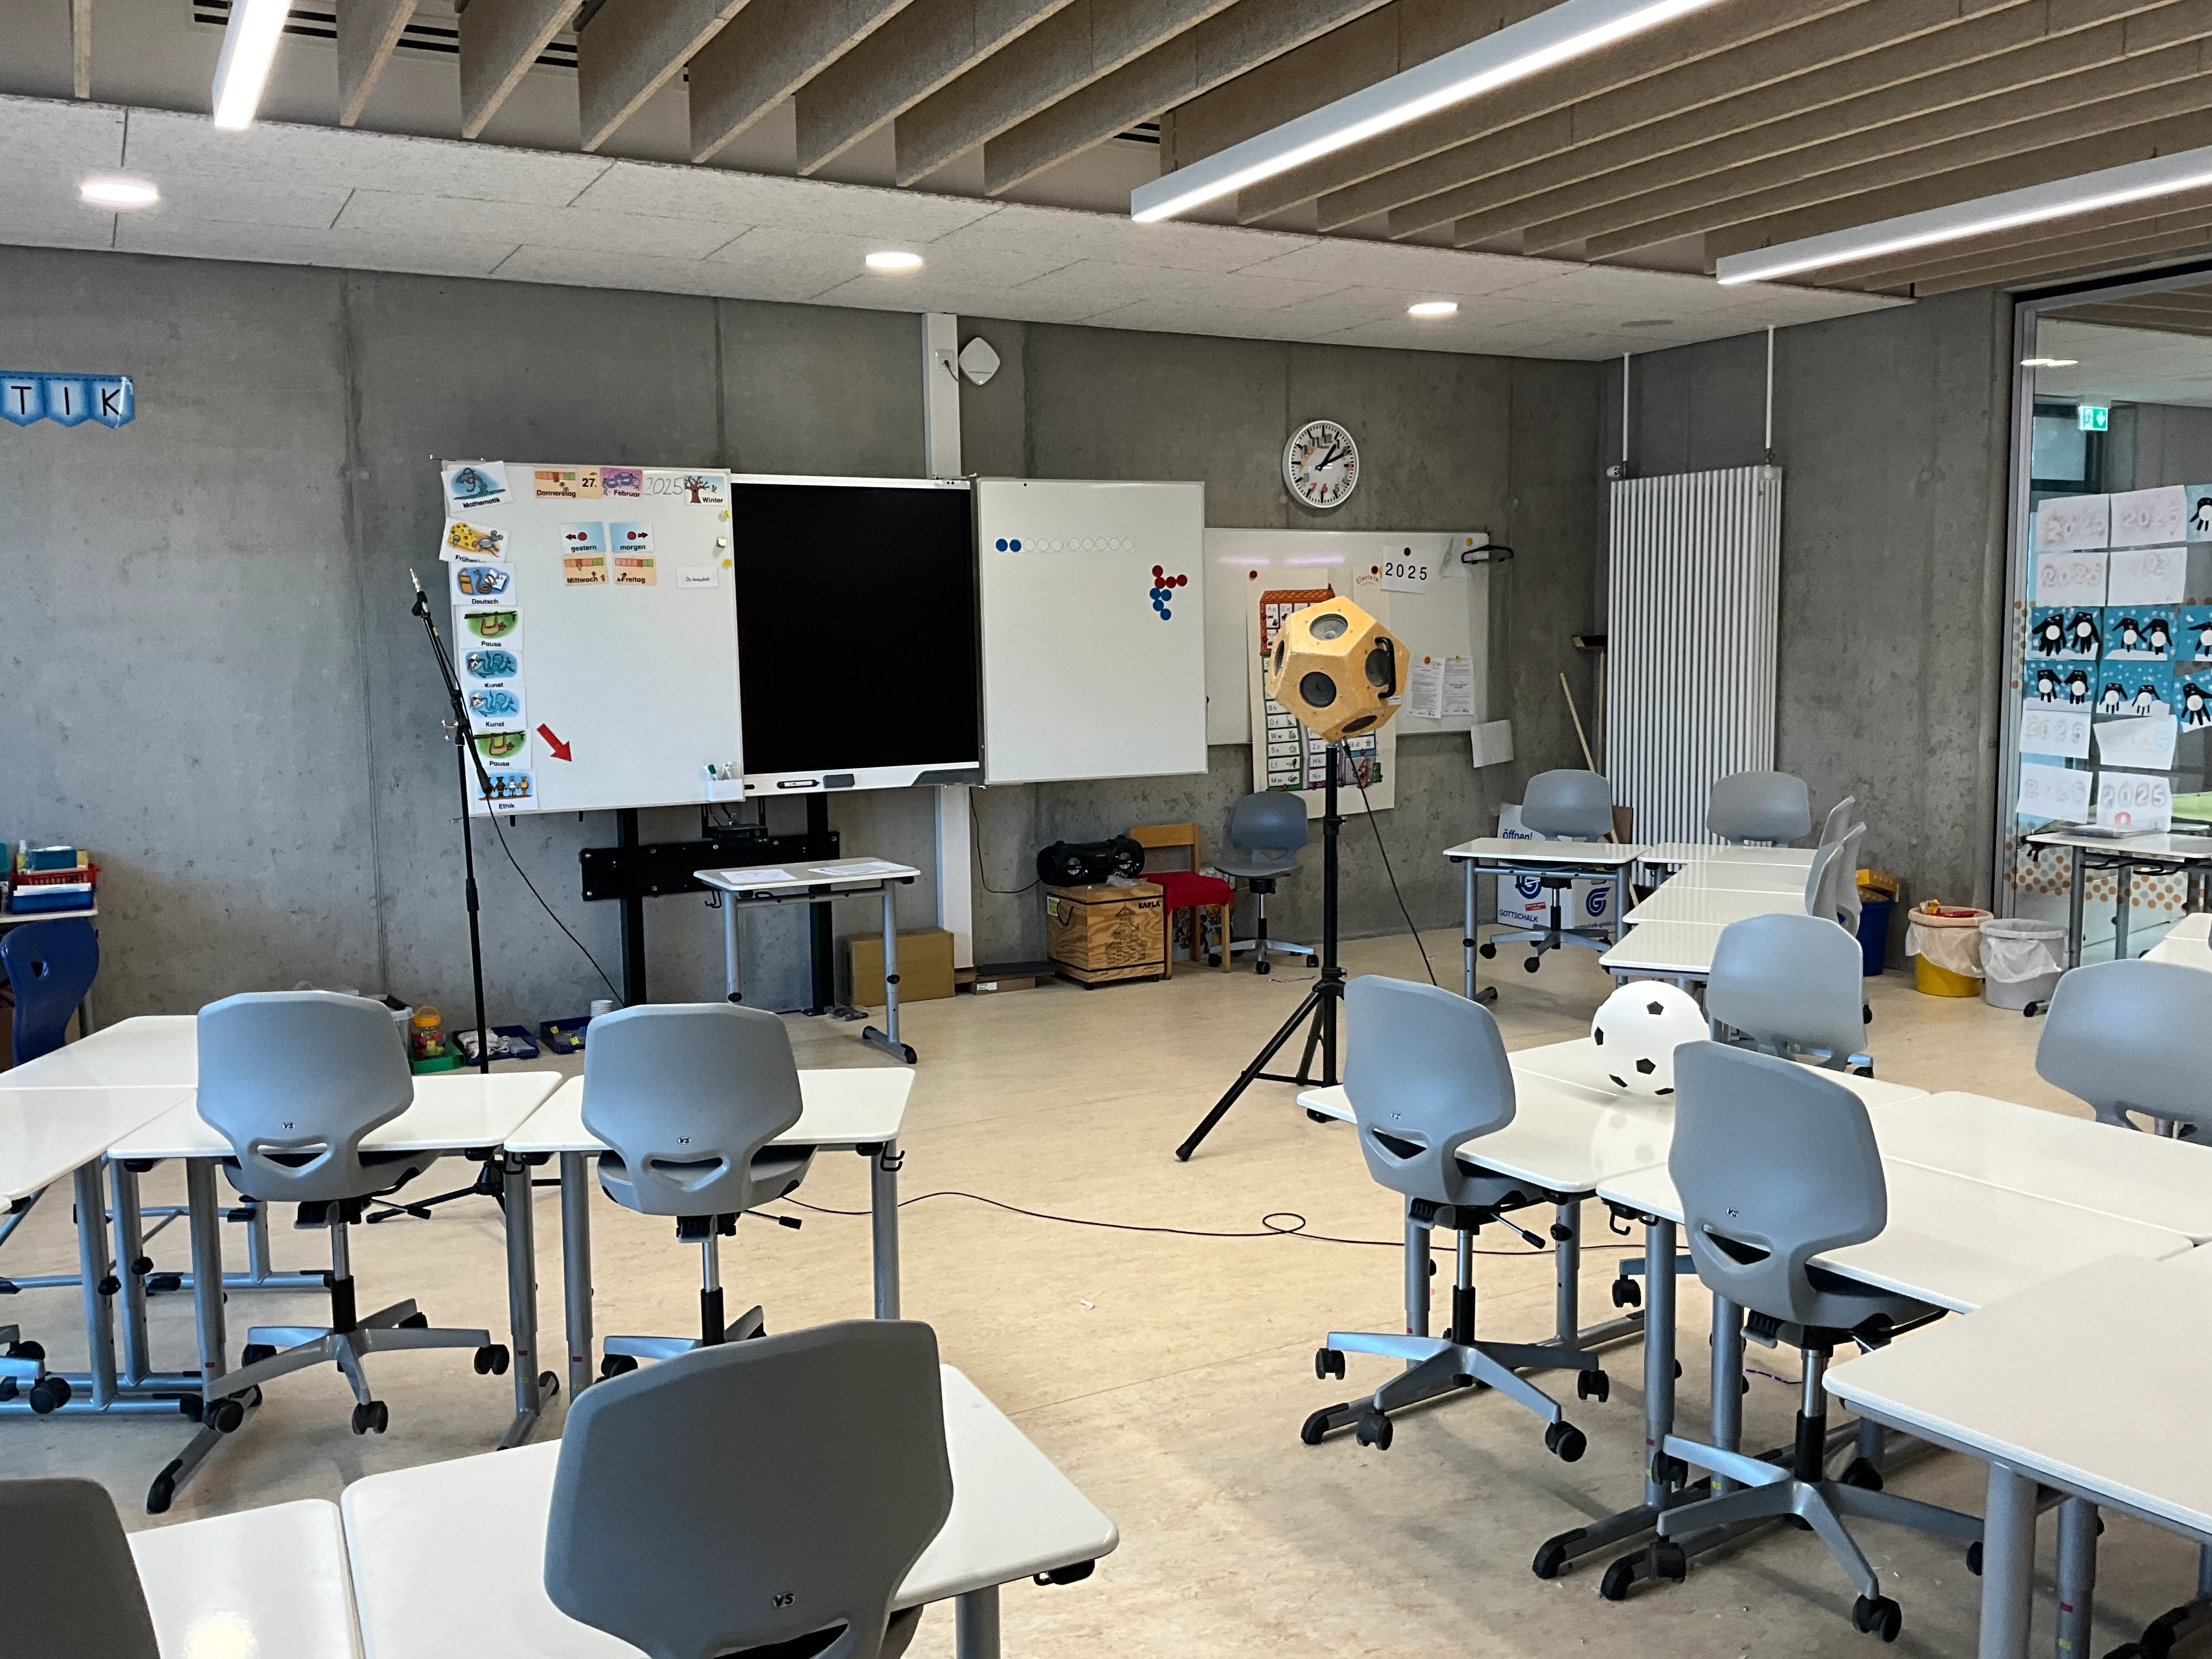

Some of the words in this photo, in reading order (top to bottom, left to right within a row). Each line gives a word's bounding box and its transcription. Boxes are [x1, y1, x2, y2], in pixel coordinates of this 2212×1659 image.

[536, 489, 576, 498] Donnerstag
[582, 478, 597, 488] 27.
[613, 489, 640, 498] Februar
[644, 477, 684, 496] 2025
[463, 497, 501, 509] Mathematik
[571, 545, 597, 553] gestern
[1385, 562, 1427, 580] 2025
[1503, 828, 1533, 840] öffnen!
[1138, 901, 1160, 909] KAPLA
[1499, 909, 1539, 923] GOTTSCHALK
[773, 1593, 794, 1607] VS
